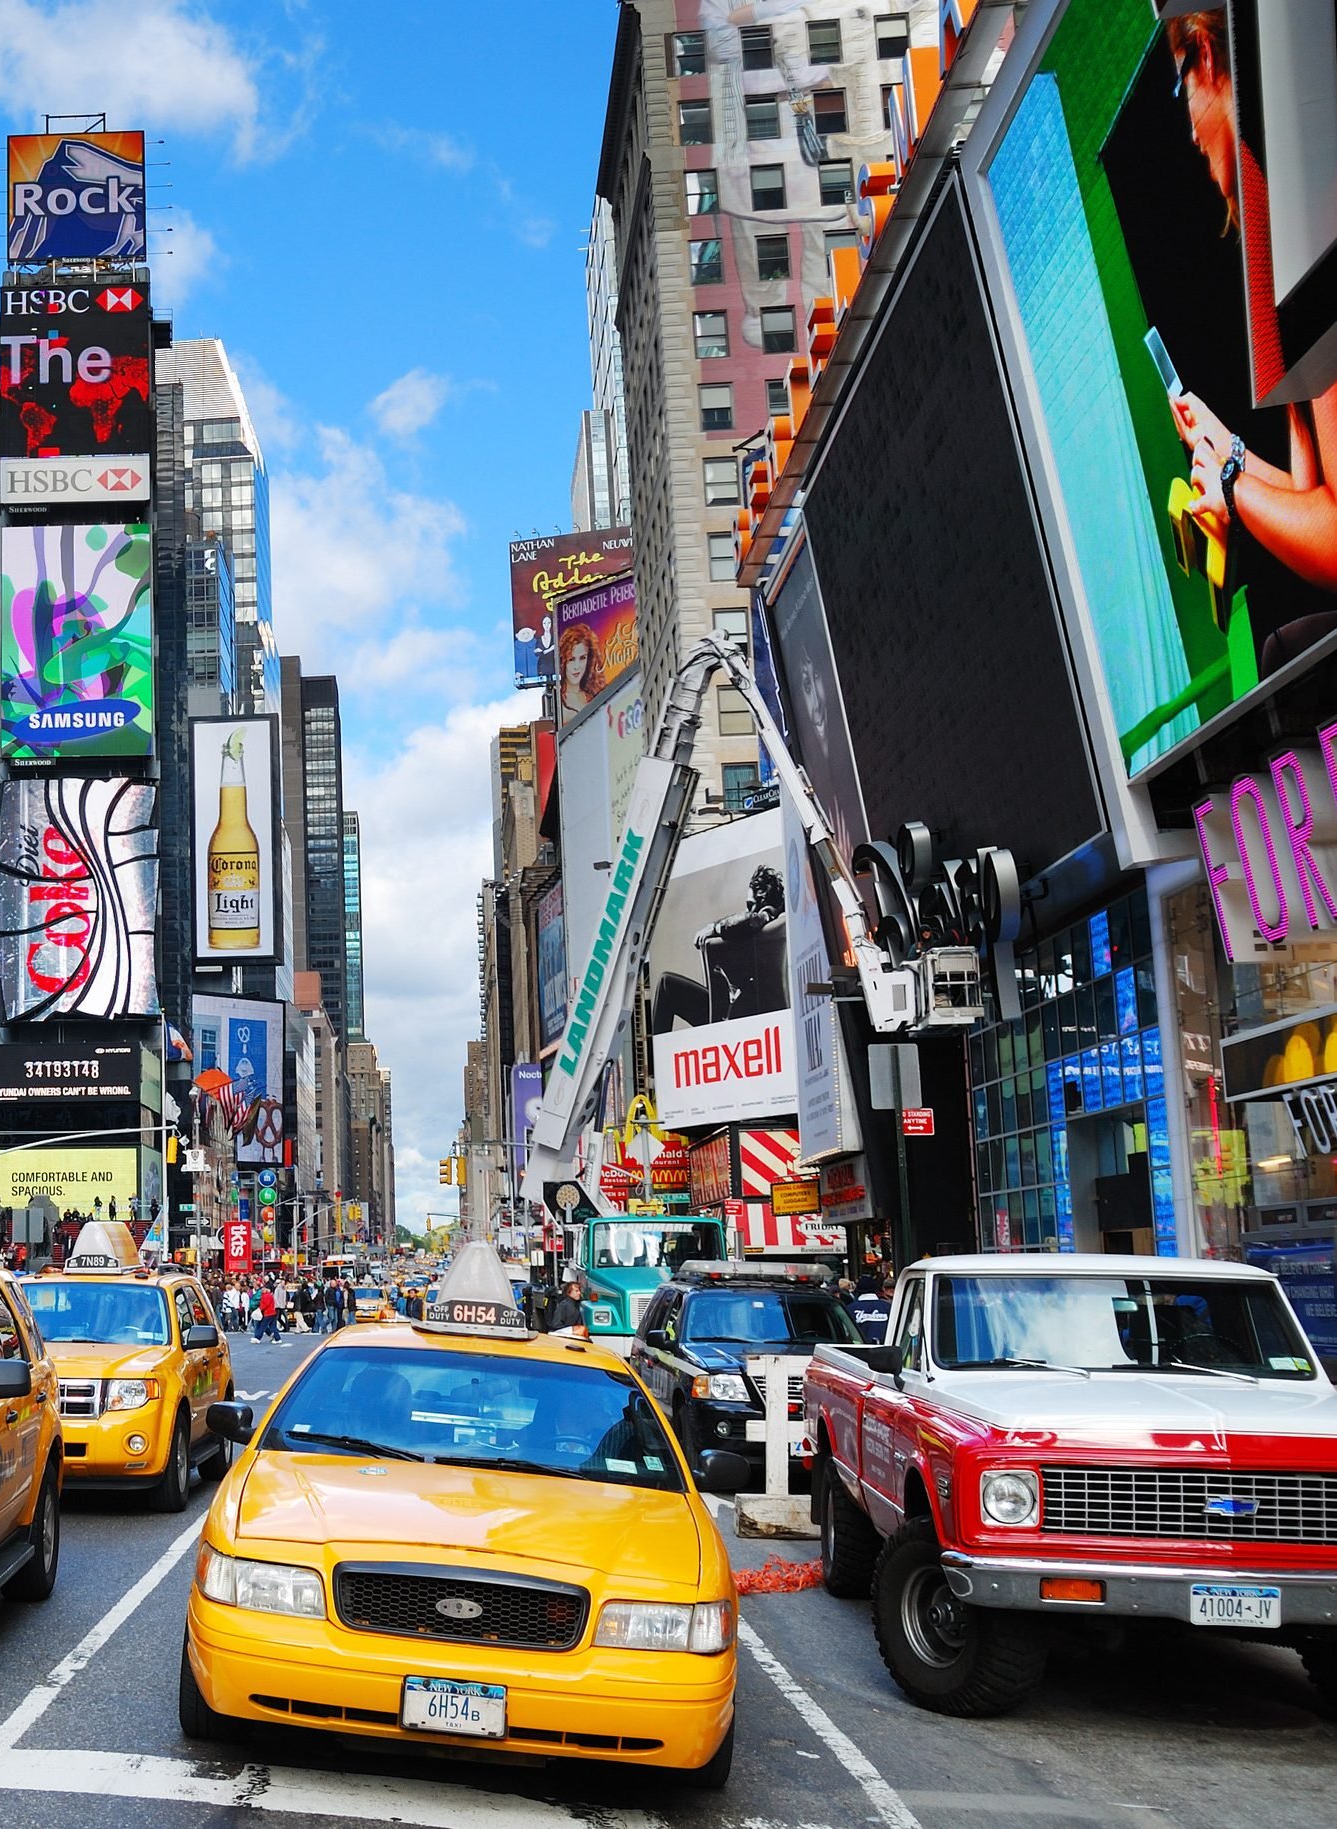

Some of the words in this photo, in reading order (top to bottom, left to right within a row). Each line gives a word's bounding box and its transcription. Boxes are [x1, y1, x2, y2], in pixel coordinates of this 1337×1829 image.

[4, 289, 90, 316] HSBC
[0, 335, 113, 385] The
[7, 468, 93, 494] HSBC
[510, 538, 555, 552] NATHAN
[511, 551, 538, 563] LANE
[558, 551, 605, 569] The
[562, 593, 608, 622] BERNADETTE
[28, 711, 125, 730] SAMSUNG
[20, 823, 40, 887] Diet
[212, 857, 258, 873] Corona
[214, 893, 255, 914] Light
[558, 827, 645, 1078] LANDMARK
[673, 1024, 783, 1090] maxell
[28, 1088, 62, 1097] OWNERS
[63, 1087, 86, 1096] CAN'T
[87, 1087, 98, 1096] BE
[99, 1086, 131, 1096] WRONG.
[11, 1171, 87, 1183] COMFORTABLE
[91, 1171, 113, 1182] AND
[11, 1184, 66, 1197] SPACIOUS.
[231, 1225, 247, 1257] tkts
[80, 1255, 105, 1266] 7N89
[429, 1312, 450, 1321] DUTY
[500, 1318, 520, 1326] DUTY
[453, 1304, 497, 1324] 6H54
[502, 1310, 519, 1318] OFF
[1212, 1589, 1231, 1597] NEW
[1234, 1589, 1257, 1598] YORK
[429, 1683, 453, 1694] NEW
[455, 1685, 482, 1698] YORK
